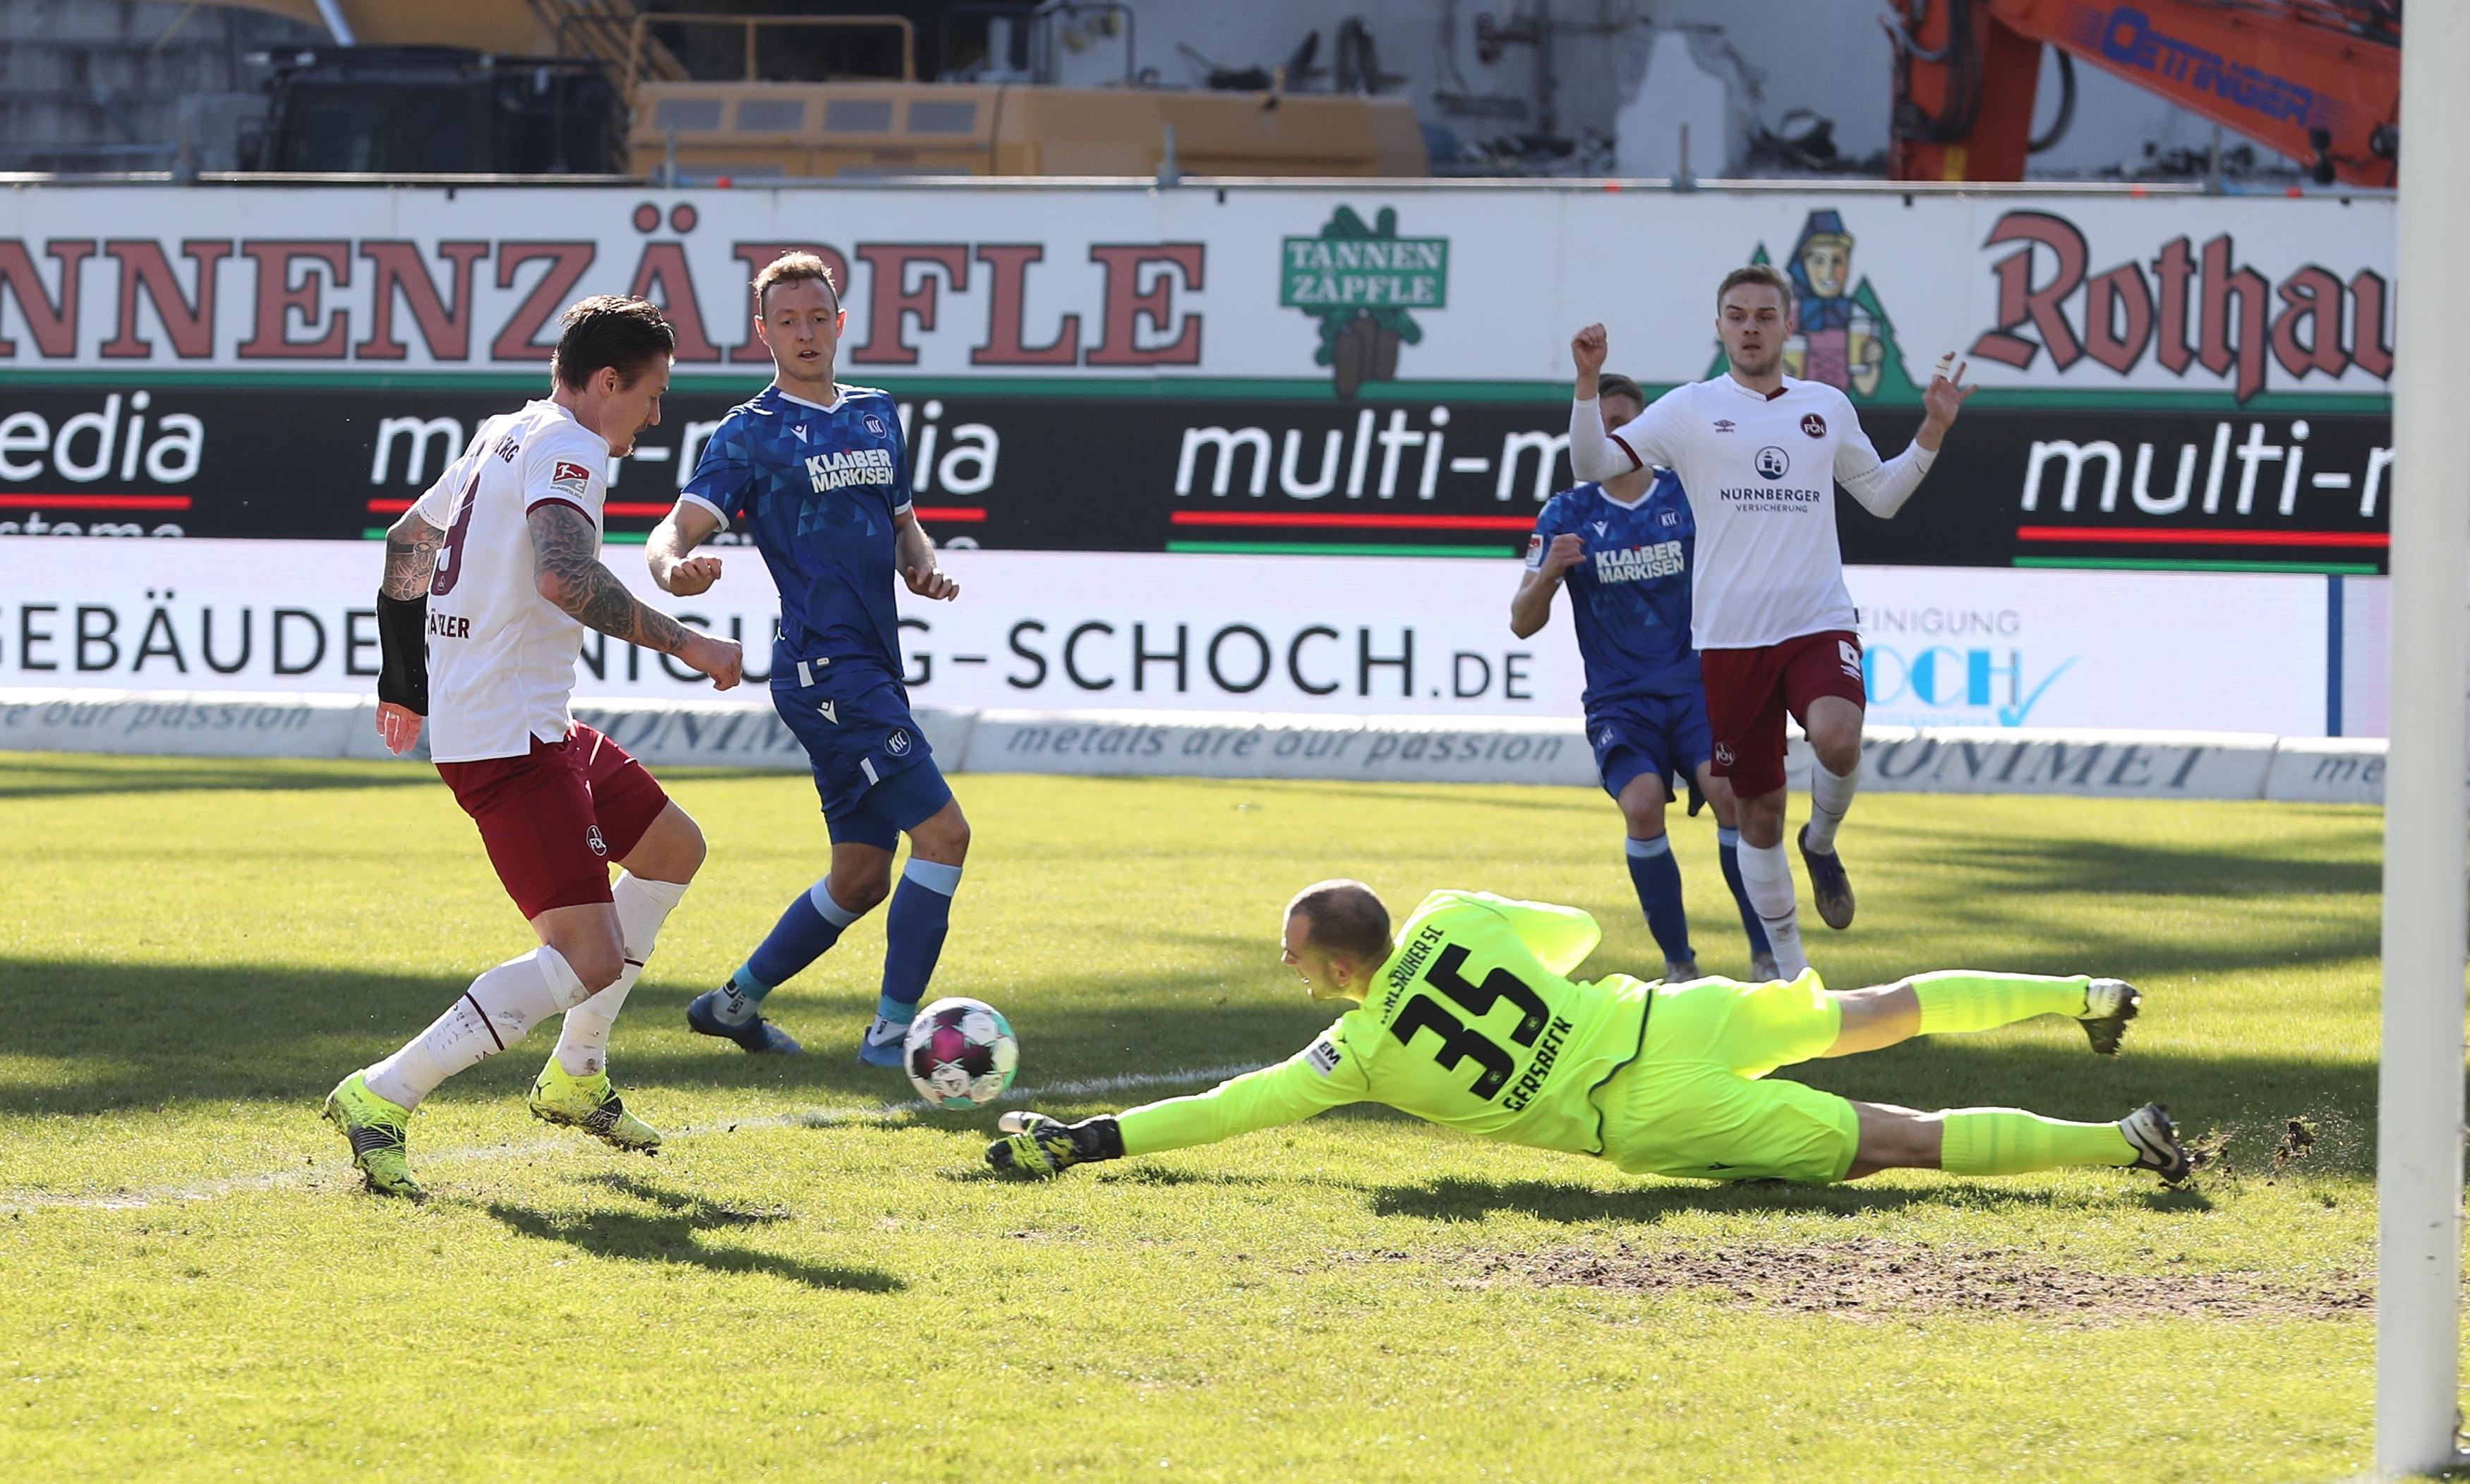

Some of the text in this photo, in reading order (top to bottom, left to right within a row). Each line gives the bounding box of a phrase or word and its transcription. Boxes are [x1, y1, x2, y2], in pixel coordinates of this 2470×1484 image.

[1287, 241, 1444, 270] TANNEN
[1291, 267, 1436, 303] ZÄPFLE
[811, 466, 893, 494] MARKISEN
[1720, 487, 1821, 503] NÜRNBERGER
[1735, 504, 1808, 513] VERSICHERUNG
[1597, 555, 1685, 584] MARKISEN
[1859, 608, 2020, 637] EINIGUNG
[126, 699, 313, 735] passion
[1006, 723, 1565, 768] metals are our passion
[1420, 924, 1446, 944] SC
[1390, 943, 1551, 1102] 35
